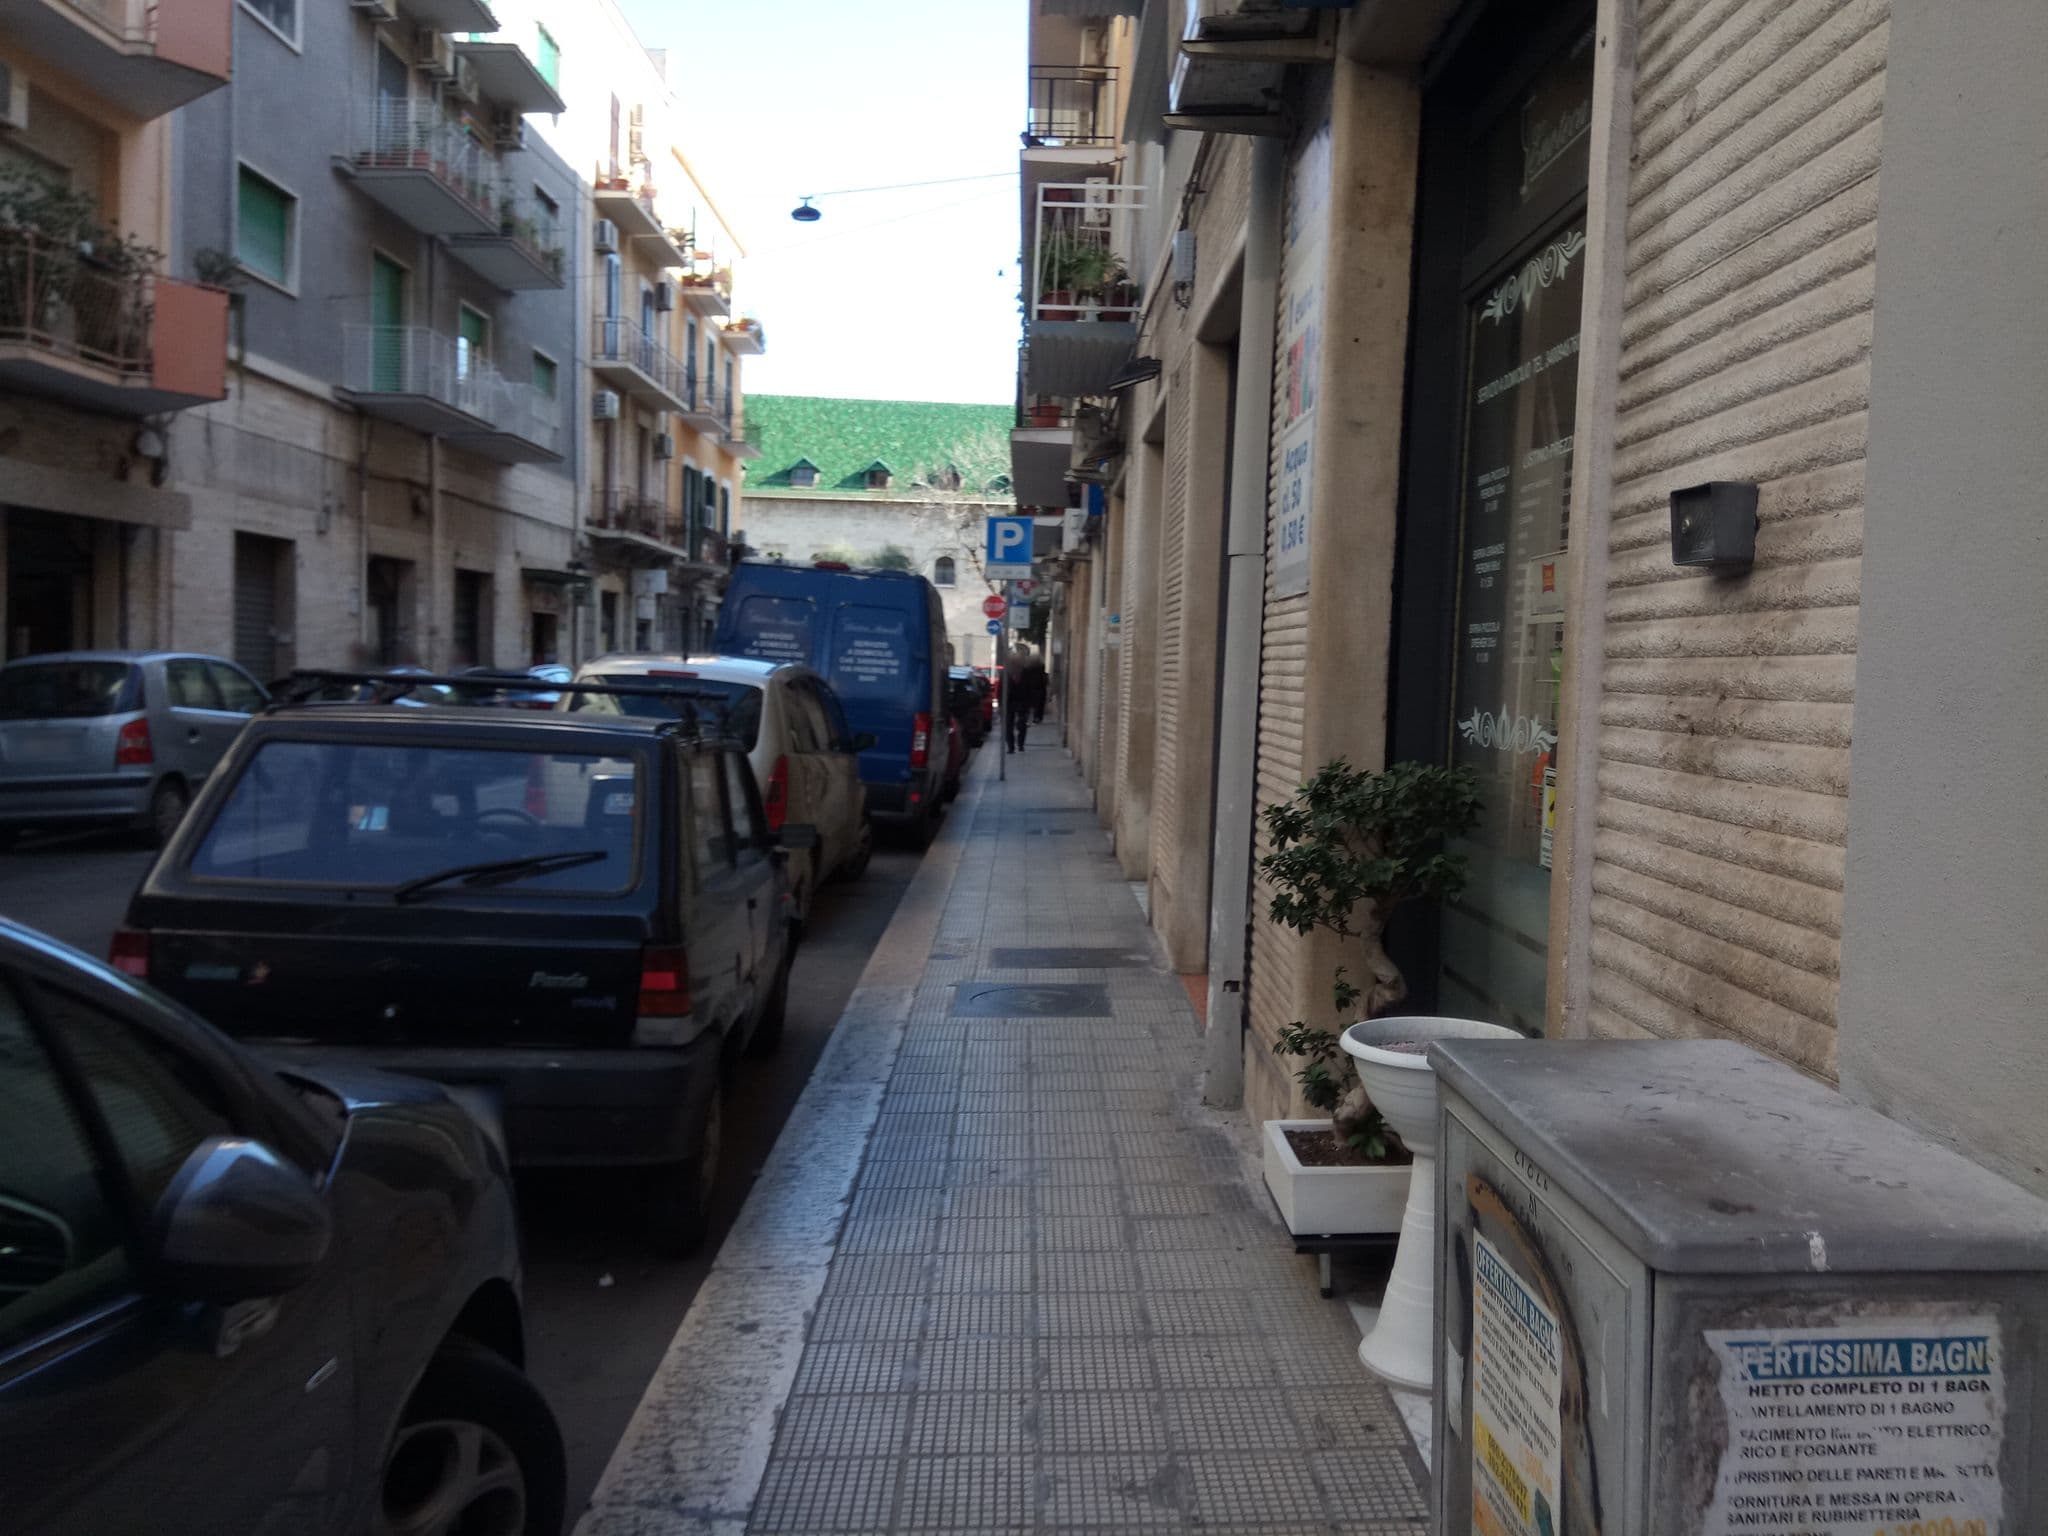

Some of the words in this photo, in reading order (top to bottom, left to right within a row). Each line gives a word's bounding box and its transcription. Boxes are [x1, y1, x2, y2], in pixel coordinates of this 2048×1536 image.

[995, 522, 1025, 559] P
[1477, 1243, 1528, 1324] OFFERTISSIMA
[1731, 1341, 1902, 1376] FERTISSIMA
[1811, 1382, 1902, 1396] COMPLETO
[1909, 1381, 1925, 1393] DI
[1931, 1381, 1938, 1393] 1
[1871, 1403, 1885, 1415] DI
[1890, 1403, 1896, 1414] 1
[1901, 1402, 1954, 1415] BAGNO
[1908, 1424, 1991, 1438] ELETTRICO
[1781, 1444, 1787, 1457] E
[1808, 1469, 1851, 1482] DELLE
[1857, 1468, 1908, 1481] PARETI
[1910, 1467, 1917, 1479] E
[1817, 1494, 1824, 1507] E
[1829, 1492, 1882, 1506] MESSA
[1886, 1491, 1900, 1504] IN
[1904, 1490, 1956, 1504] OPERA
[1799, 1511, 1807, 1525] E
[1812, 1508, 1922, 1523] RUBINETTERIA
